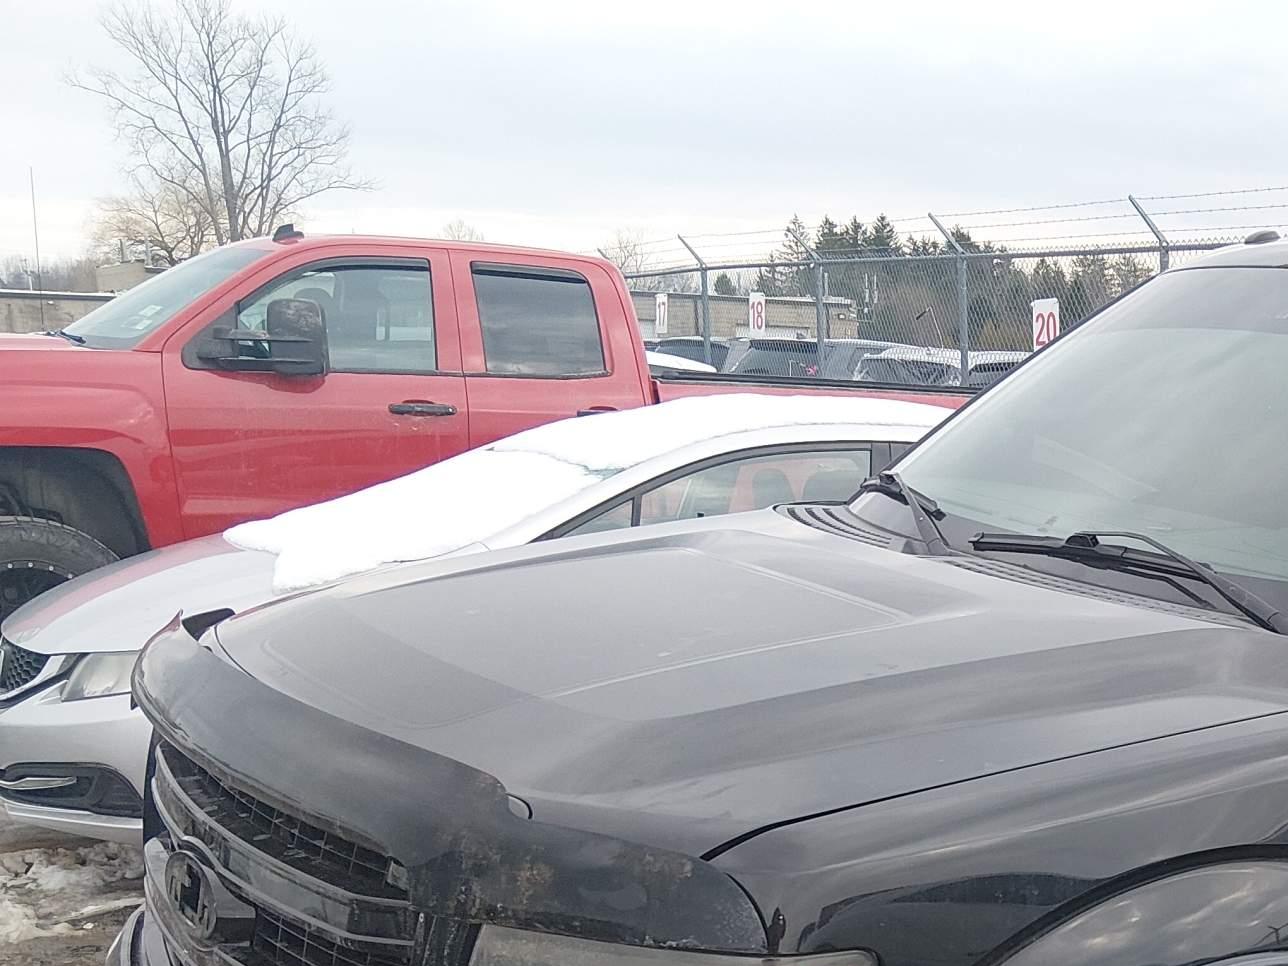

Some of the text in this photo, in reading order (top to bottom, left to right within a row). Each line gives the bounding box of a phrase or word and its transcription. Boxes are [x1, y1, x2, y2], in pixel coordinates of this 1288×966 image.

[657, 301, 667, 327] 17
[751, 300, 763, 330] 18
[1035, 311, 1057, 346] 20
